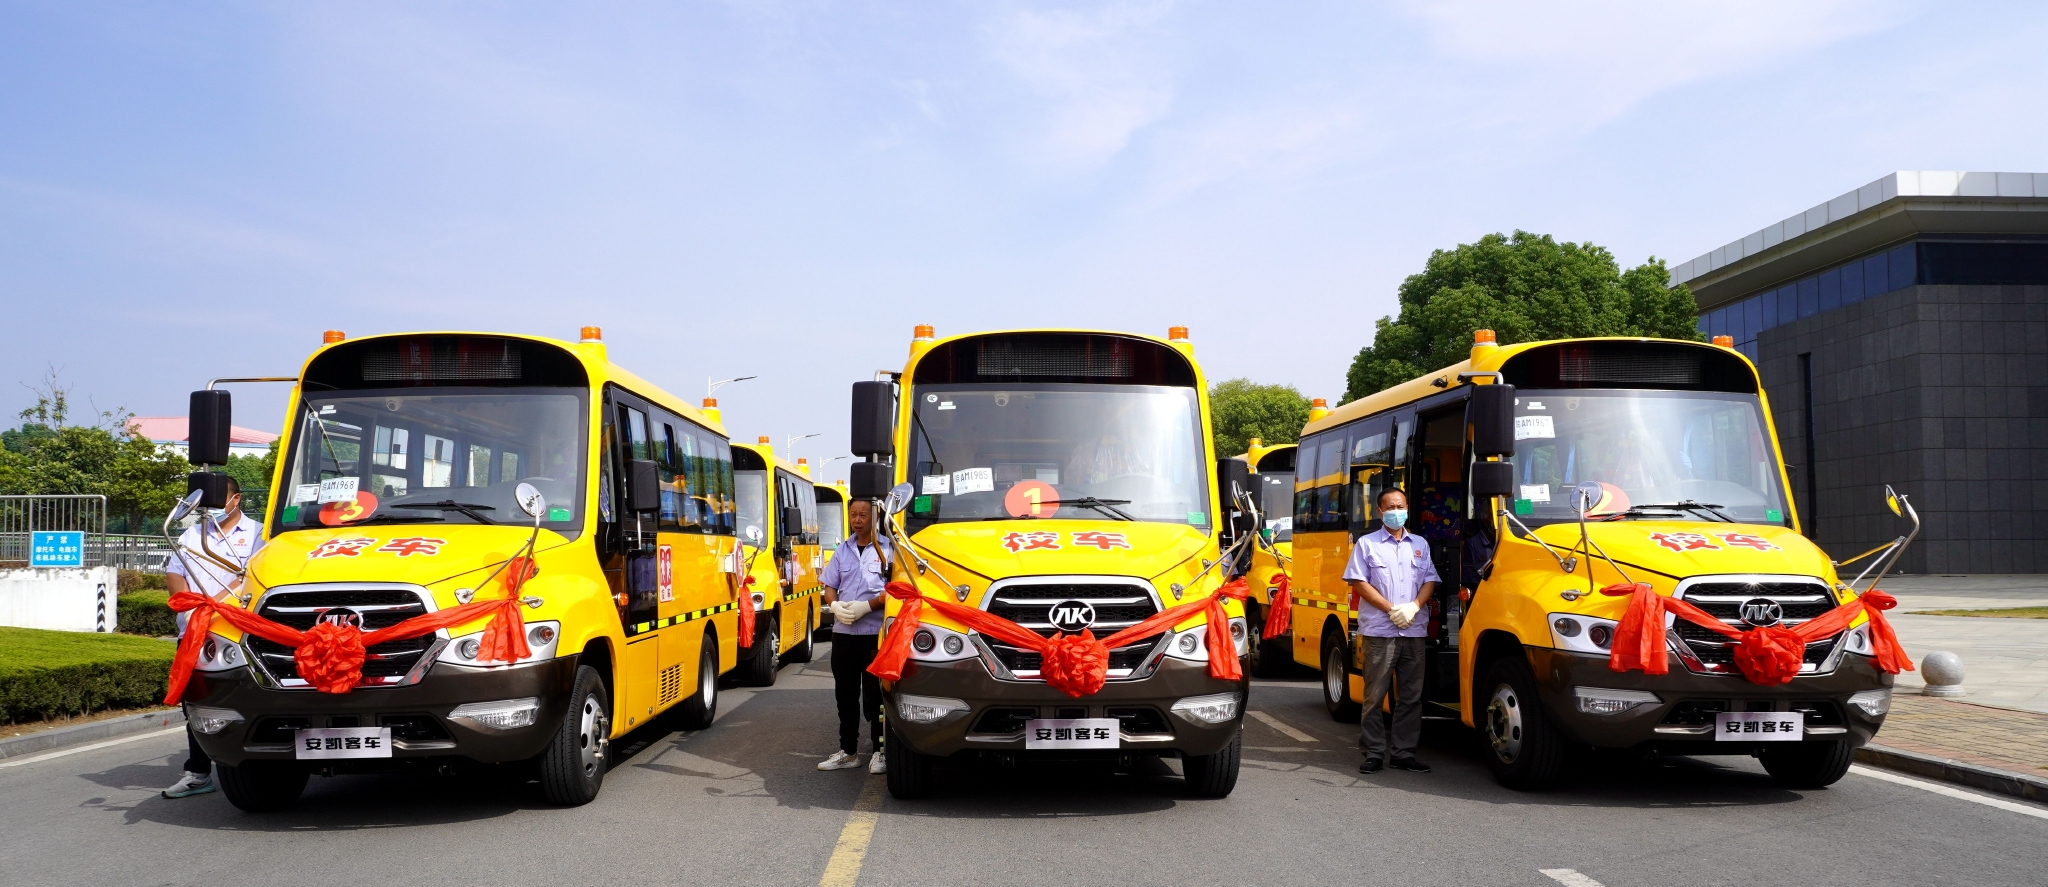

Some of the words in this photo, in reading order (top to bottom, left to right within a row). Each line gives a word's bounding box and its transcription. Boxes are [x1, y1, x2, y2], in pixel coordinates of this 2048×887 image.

[334, 498, 364, 521] 3
[1023, 487, 1041, 515] 1
[308, 537, 447, 559] 校车
[1003, 531, 1131, 552] 校车
[1649, 532, 1782, 552] 校车
[1035, 727, 1110, 740] 安凯客车
[1725, 721, 1794, 733] 安凯客车
[305, 737, 381, 751] 安凯客车
